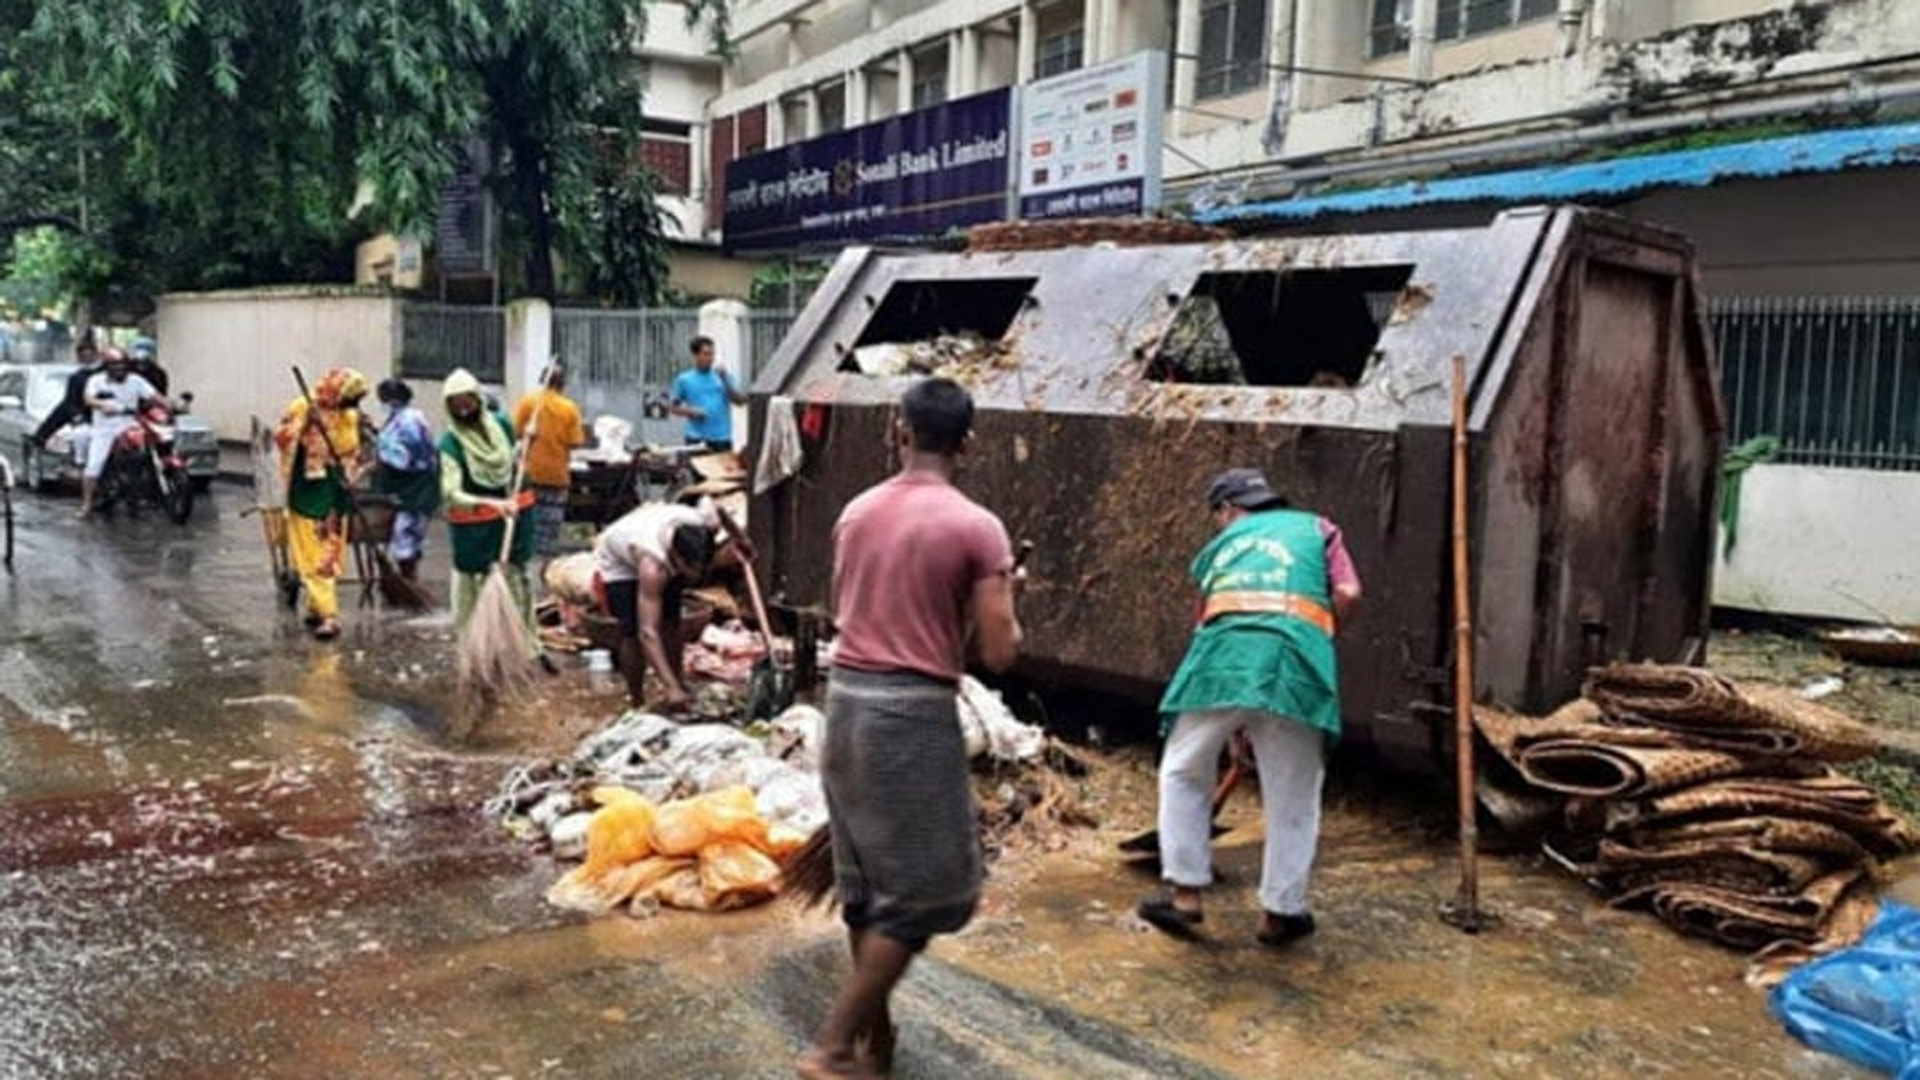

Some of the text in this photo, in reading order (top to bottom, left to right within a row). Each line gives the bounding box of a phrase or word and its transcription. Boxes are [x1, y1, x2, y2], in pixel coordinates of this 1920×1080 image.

[856, 154, 897, 184] Sonali
[900, 146, 938, 176] Bank
[943, 131, 1006, 168] Limited
